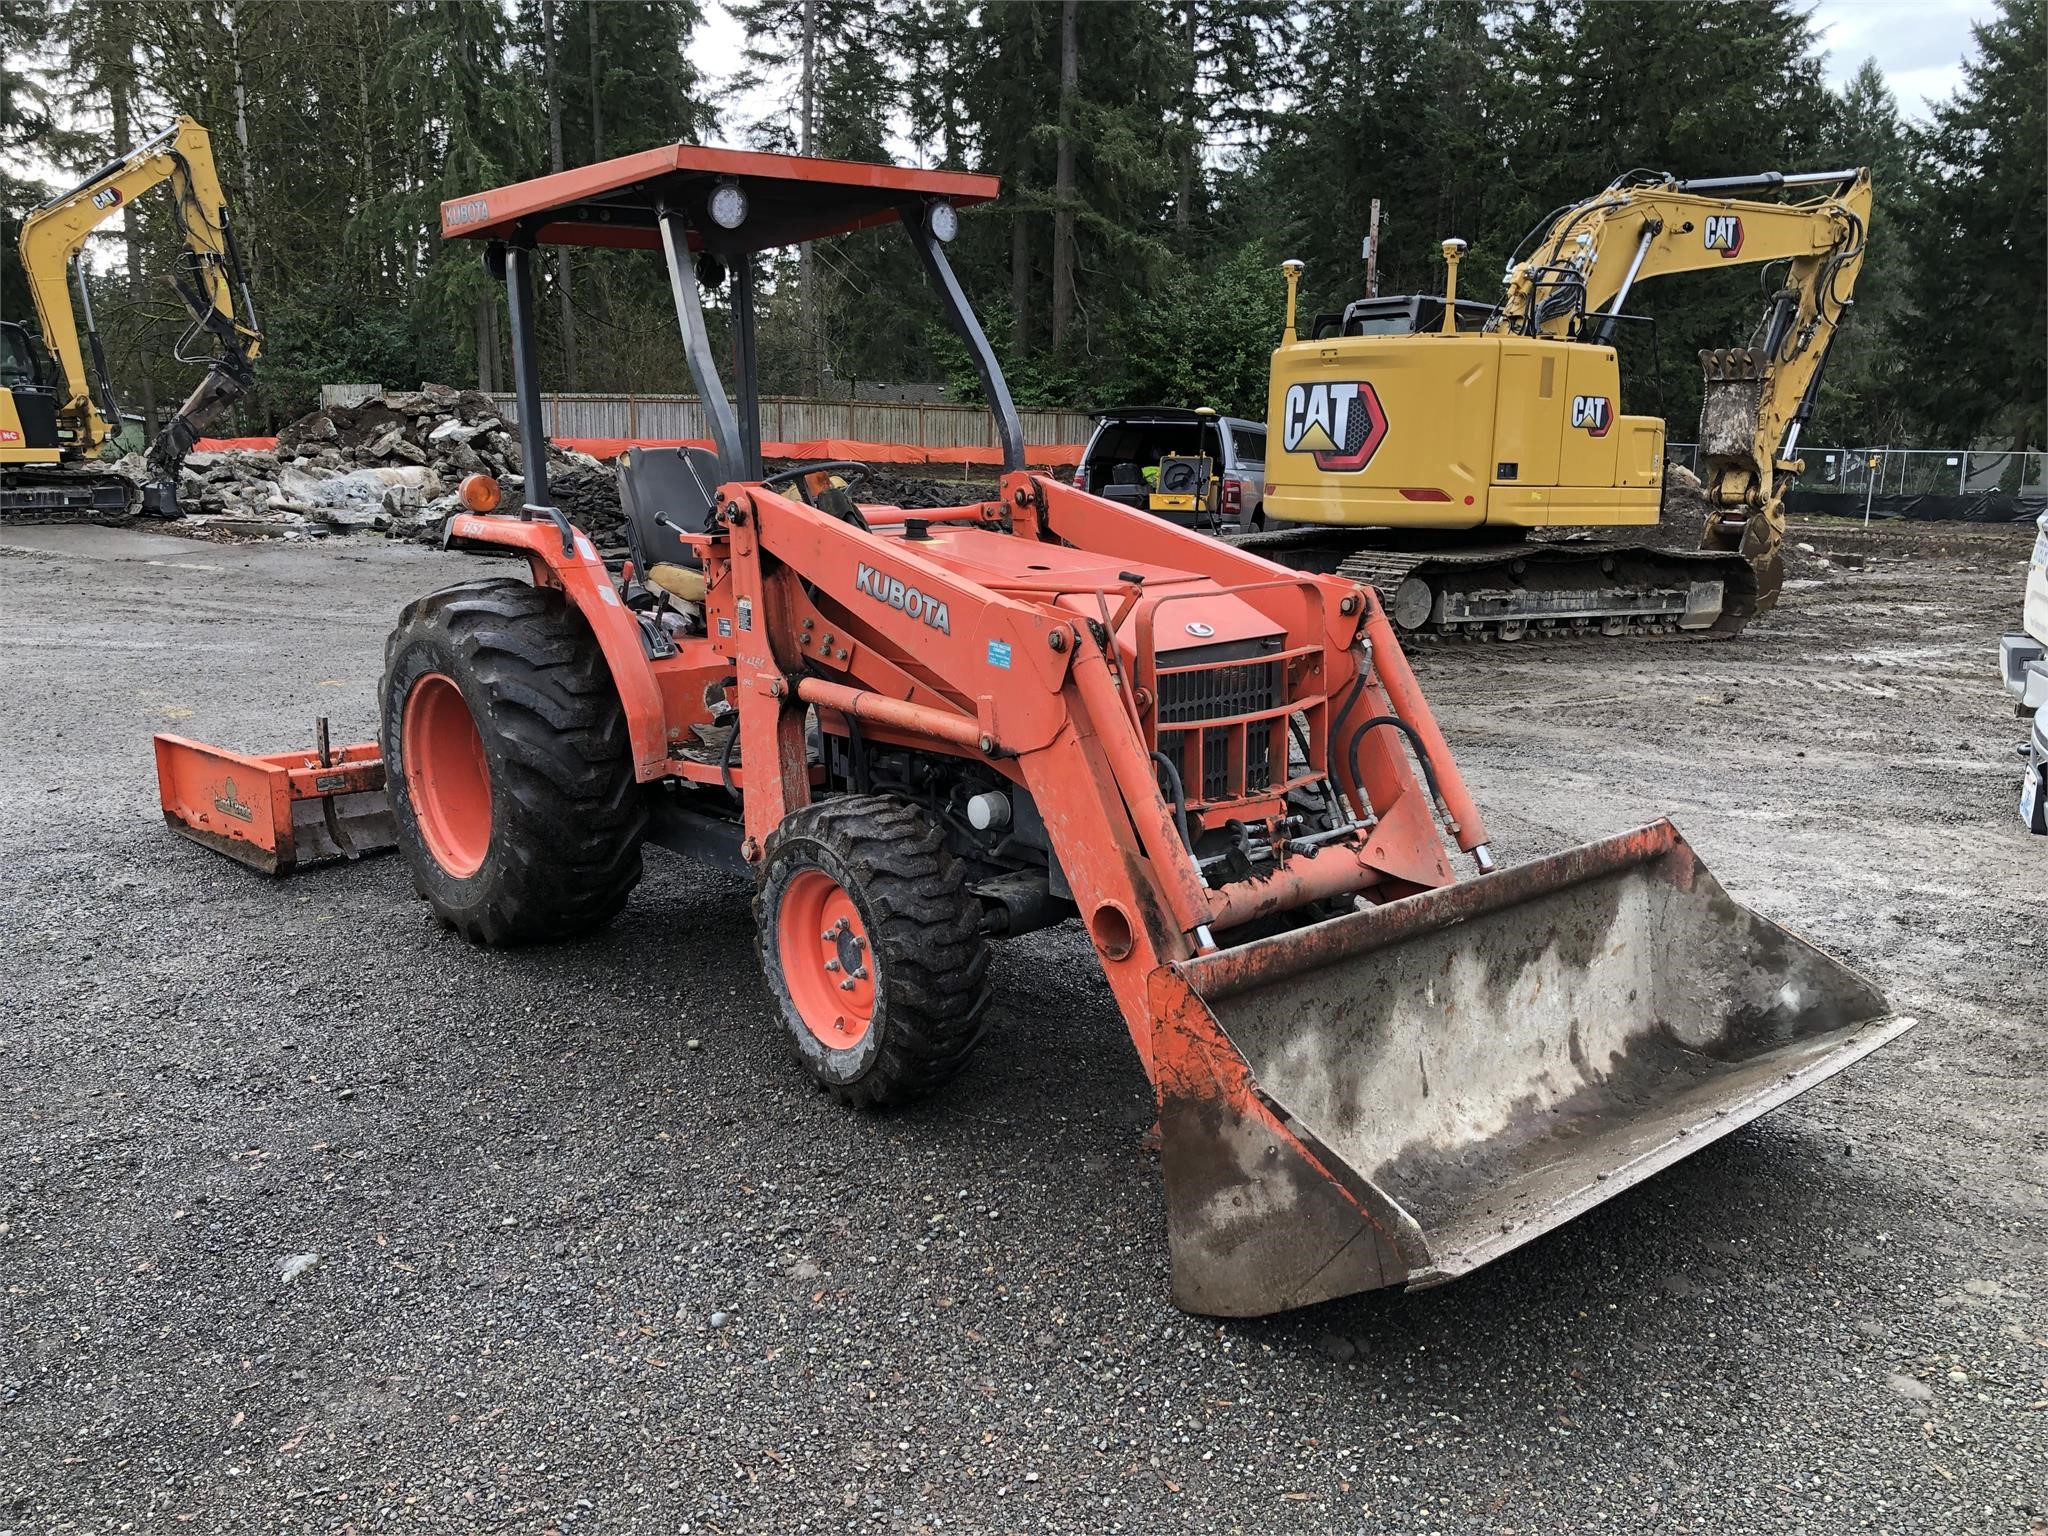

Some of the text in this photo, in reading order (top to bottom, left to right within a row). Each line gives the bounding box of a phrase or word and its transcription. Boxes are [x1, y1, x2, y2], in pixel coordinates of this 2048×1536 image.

[92, 188, 117, 210] CAT
[445, 200, 490, 227] KUBOTA
[1705, 216, 1737, 249] CAT
[1284, 383, 1360, 452] CAT
[1572, 397, 1607, 428] CAT
[856, 562, 951, 635] KUBOTA
